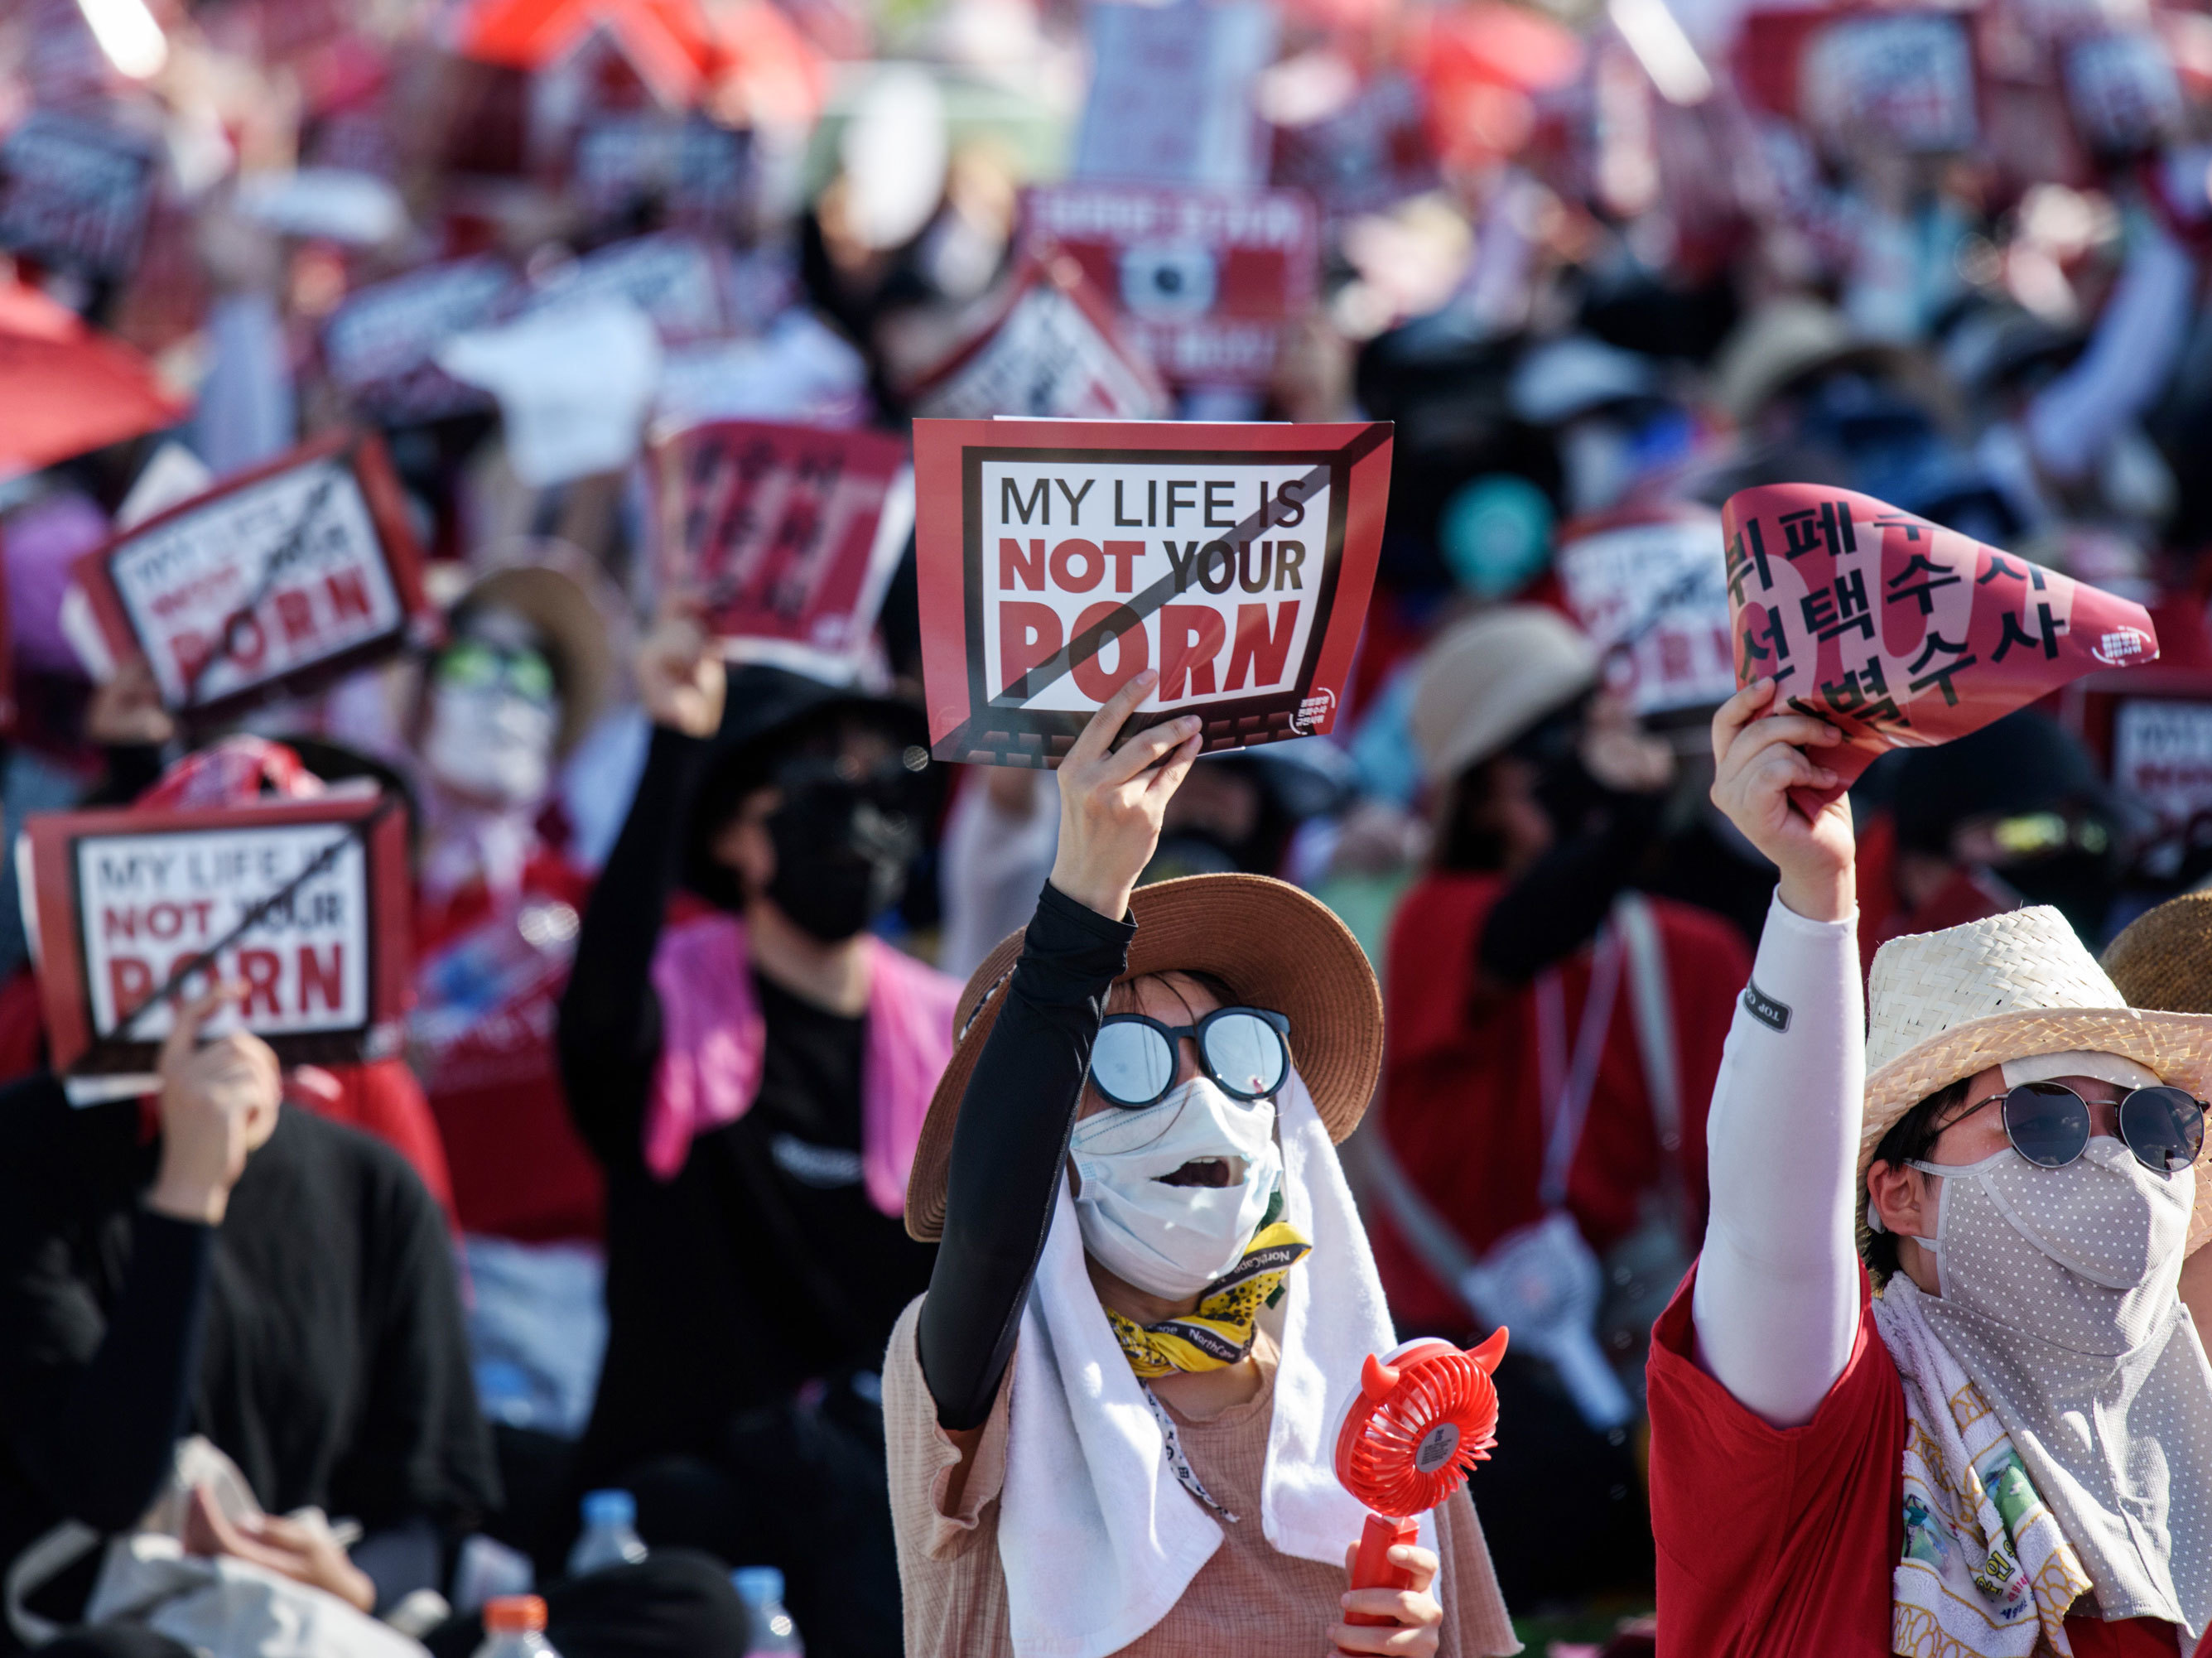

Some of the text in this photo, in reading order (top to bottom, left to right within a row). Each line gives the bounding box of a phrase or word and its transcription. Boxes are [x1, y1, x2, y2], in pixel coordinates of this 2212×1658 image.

[1000, 477, 1307, 528] MY LIFE IS
[999, 537, 1307, 595] NOT YOUR
[999, 600, 1302, 703] PORN
[103, 899, 215, 942] NOT
[108, 942, 344, 1024] PORN
